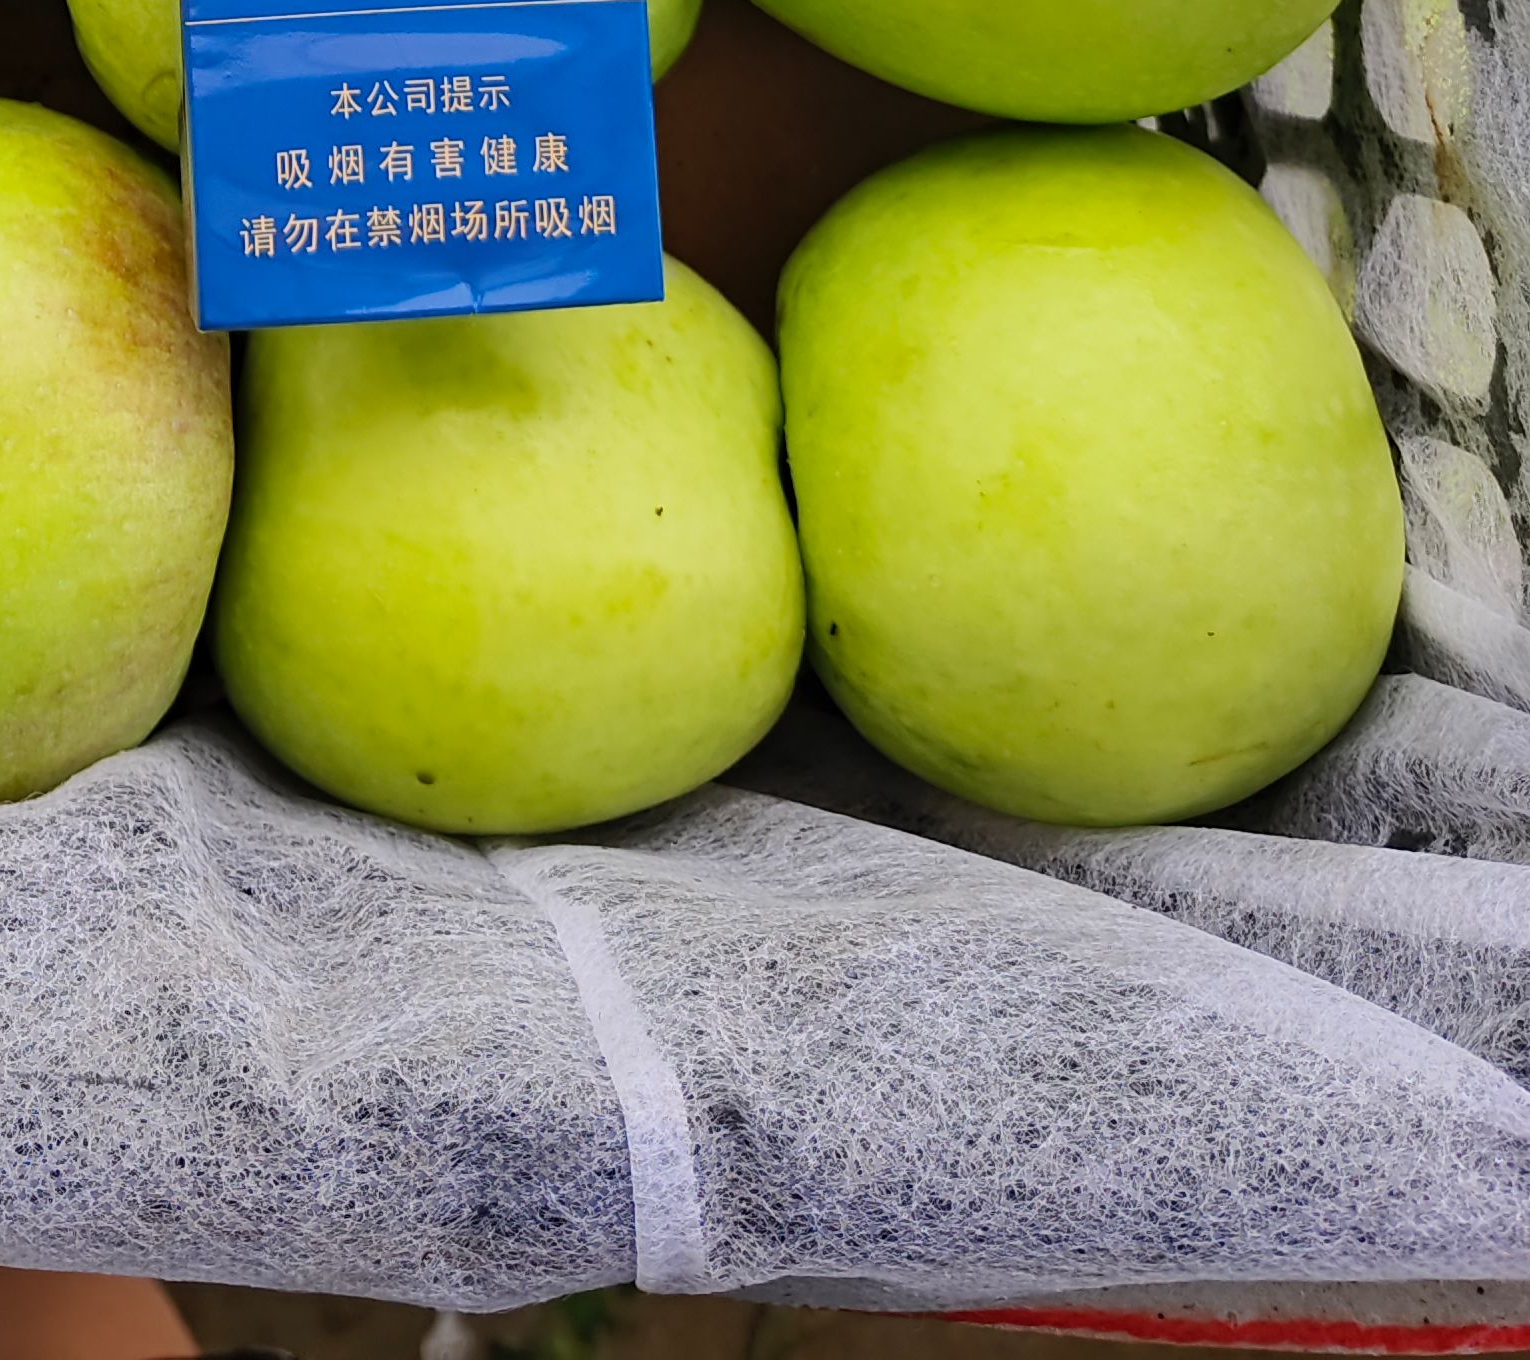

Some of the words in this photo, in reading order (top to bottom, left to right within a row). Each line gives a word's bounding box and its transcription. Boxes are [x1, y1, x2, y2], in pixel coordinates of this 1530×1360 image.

[330, 75, 511, 119] 本公司提示
[276, 131, 570, 190] 吸烟有害健康
[239, 195, 617, 258] 请勿在禁烟场所吸烟
